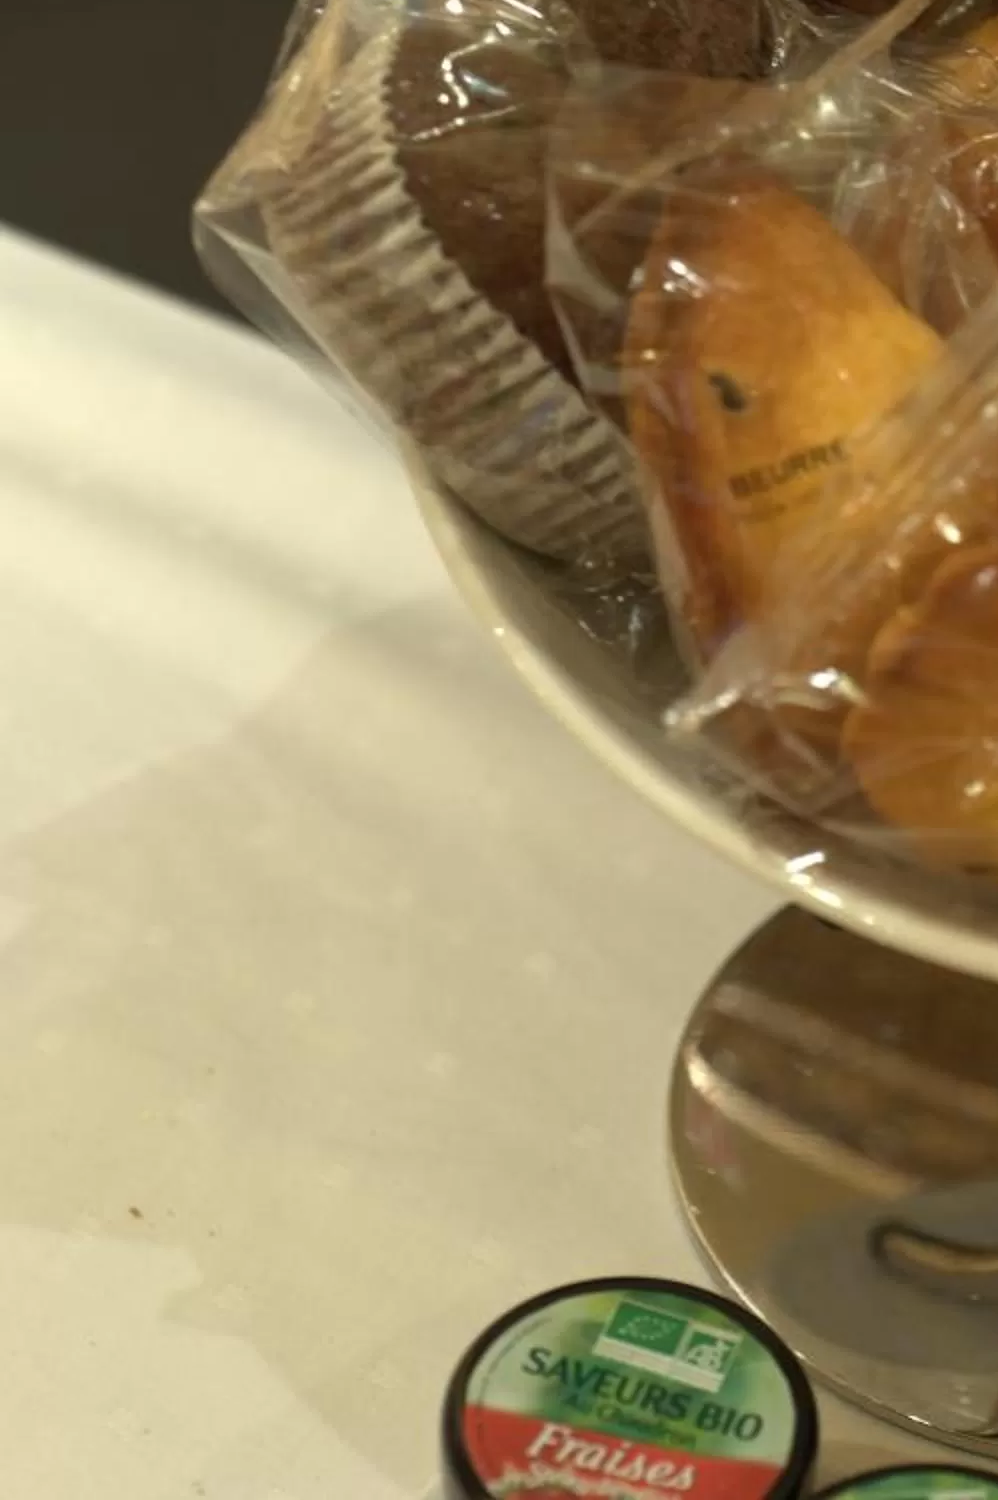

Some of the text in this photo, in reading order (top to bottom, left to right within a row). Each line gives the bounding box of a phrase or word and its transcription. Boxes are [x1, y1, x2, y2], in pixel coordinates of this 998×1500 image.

[521, 1347, 693, 1421] SAVEURS
[695, 1401, 764, 1442] BIO
[525, 1421, 698, 1491] Fraises
